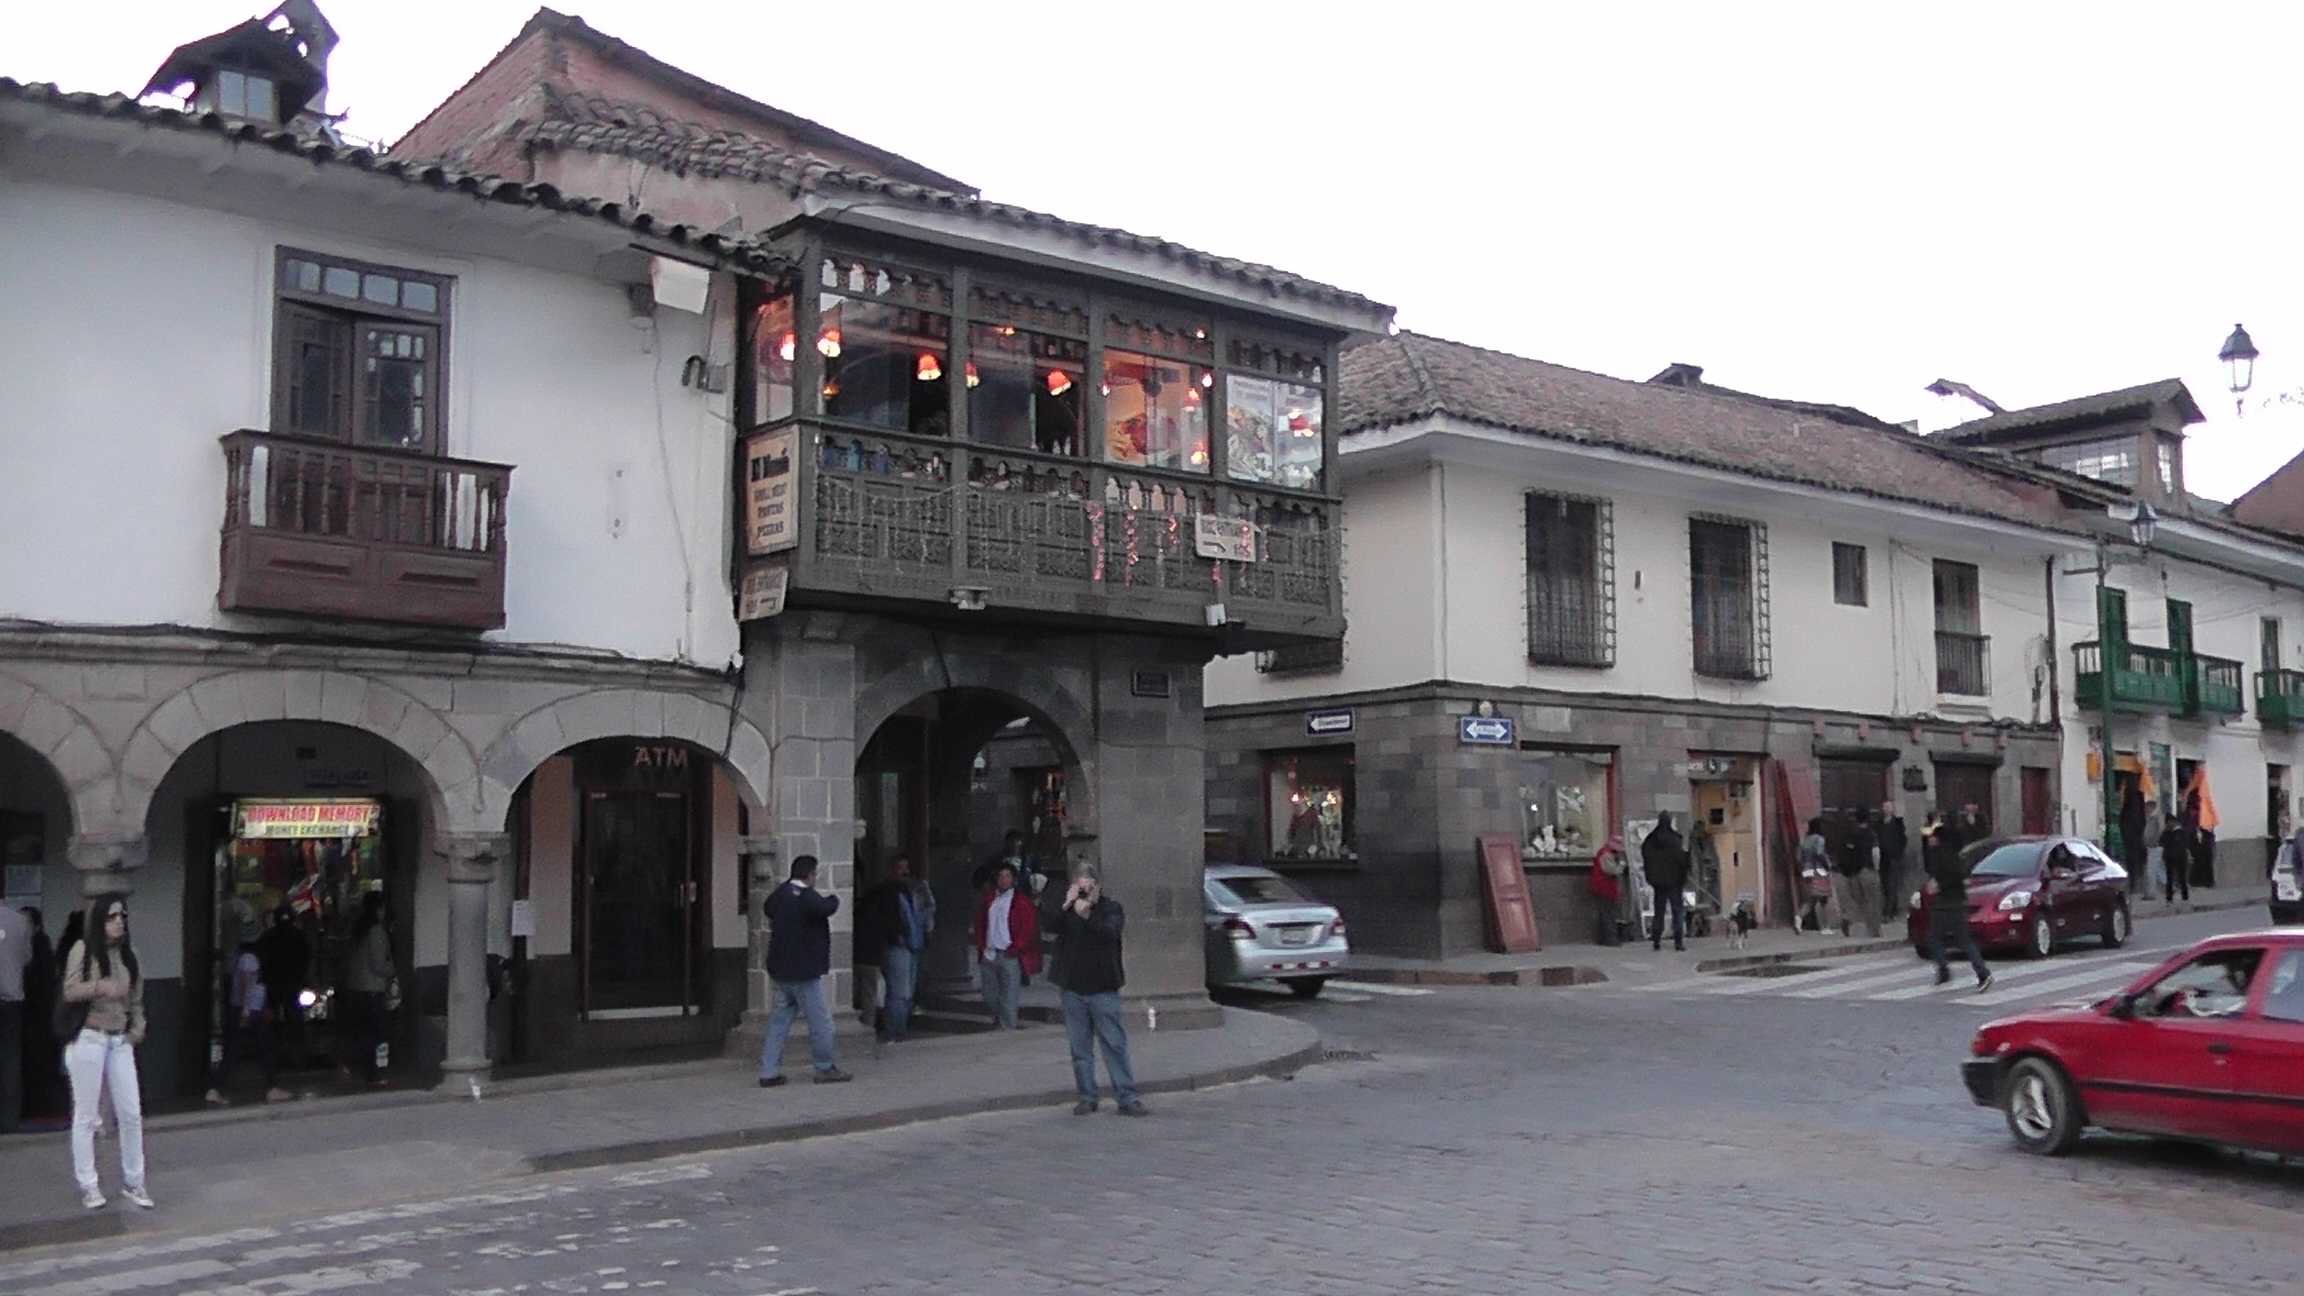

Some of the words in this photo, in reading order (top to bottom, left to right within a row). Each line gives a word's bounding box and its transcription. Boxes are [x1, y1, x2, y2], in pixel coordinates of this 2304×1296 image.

[633, 746, 689, 768] ATM
[248, 805, 316, 823] DOWNLOAD
[318, 805, 370, 823] MEMORY
